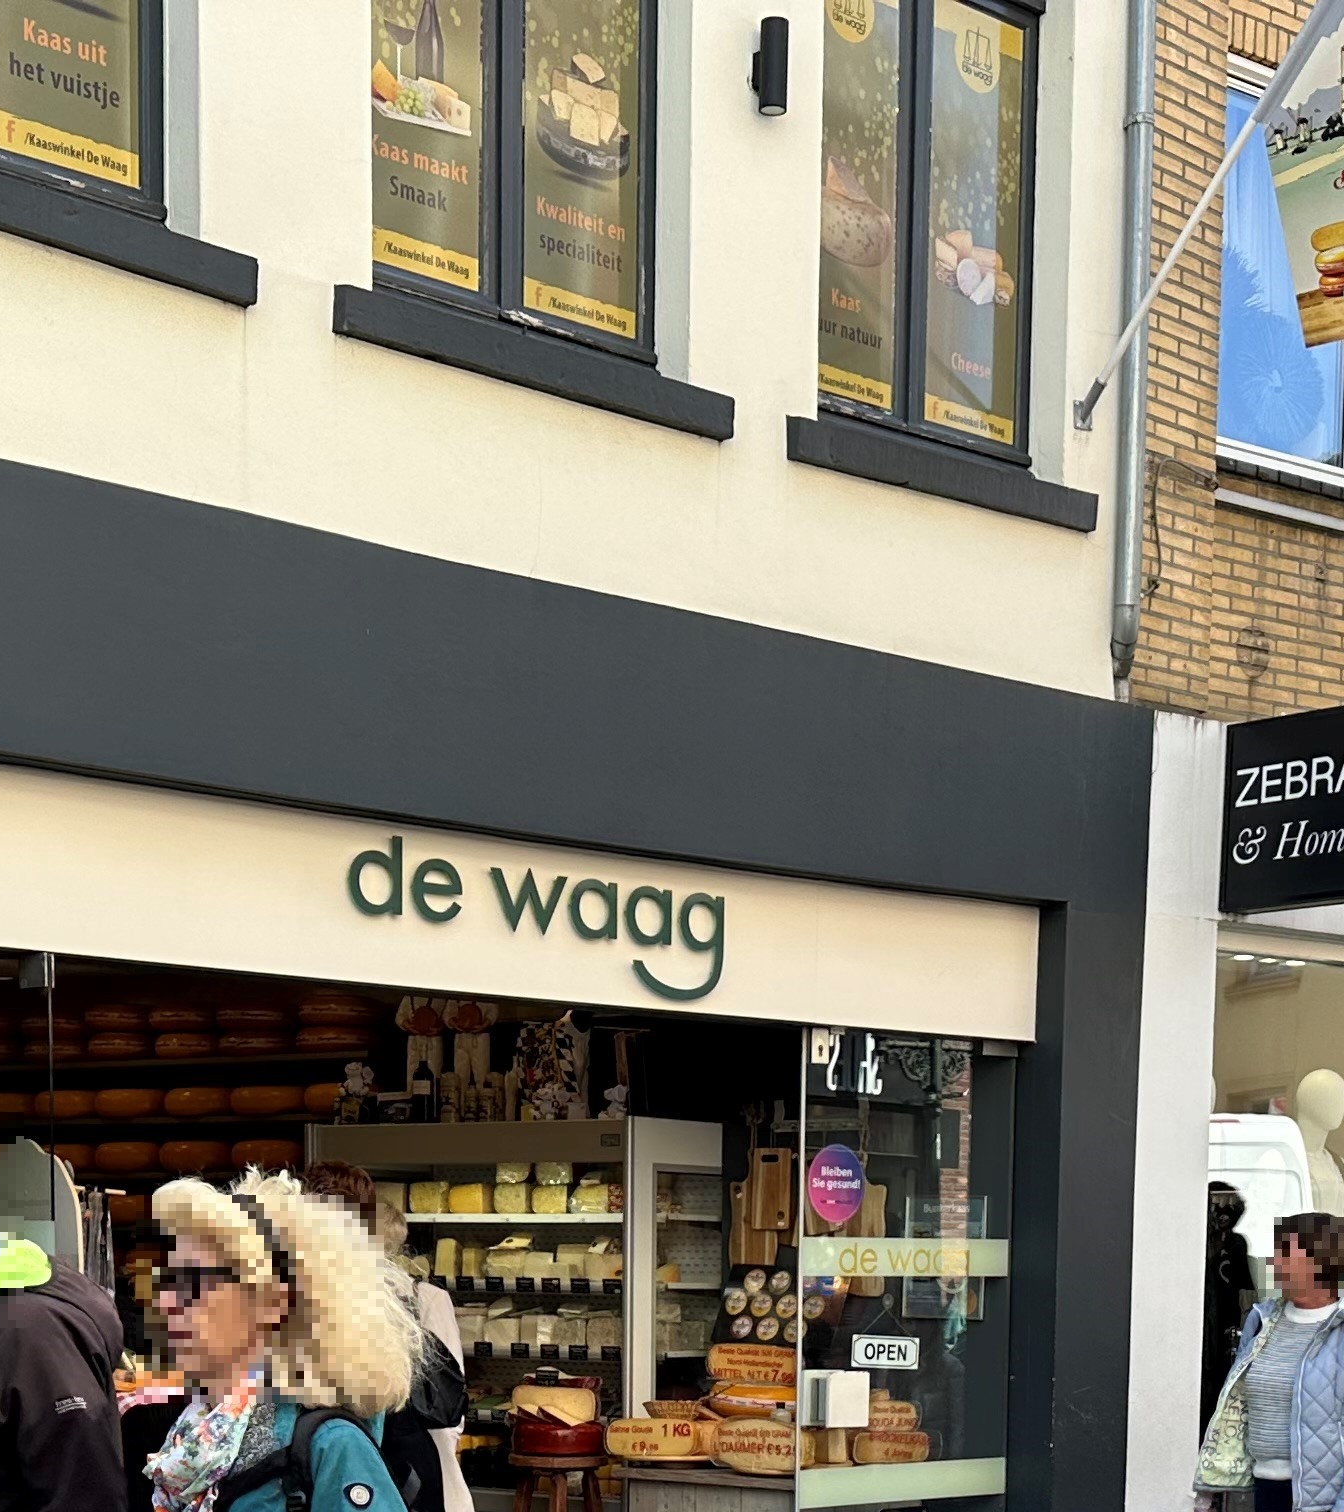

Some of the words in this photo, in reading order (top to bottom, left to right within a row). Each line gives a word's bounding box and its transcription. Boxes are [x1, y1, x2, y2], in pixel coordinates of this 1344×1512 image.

[23, 17, 72, 55] Kaas
[77, 40, 107, 67] uit
[9, 51, 45, 85] het
[50, 71, 120, 110] vuistje
[24, 132, 85, 161] /Kaaswinkel
[86, 150, 100, 166] De
[101, 154, 128, 176] Waag
[413, 151, 469, 185] maakt
[389, 175, 447, 212] Smaak
[536, 195, 605, 236] Kwaliteit
[608, 223, 625, 243] en
[435, 256, 446, 269] De
[447, 260, 470, 280] Waag
[539, 233, 623, 273] specialiteit
[831, 287, 861, 313] Kaas
[818, 317, 837, 336] uur
[840, 323, 883, 350] natuur
[951, 352, 992, 380] Cheese
[1231, 827, 1268, 866] &
[347, 836, 464, 923] de
[489, 866, 726, 1000] waag
[812, 1177, 826, 1188] Sie
[821, 1165, 853, 1177] Bleiben
[838, 1242, 878, 1274] de
[864, 1343, 907, 1361] OPEN
[672, 1423, 691, 1437] KG
